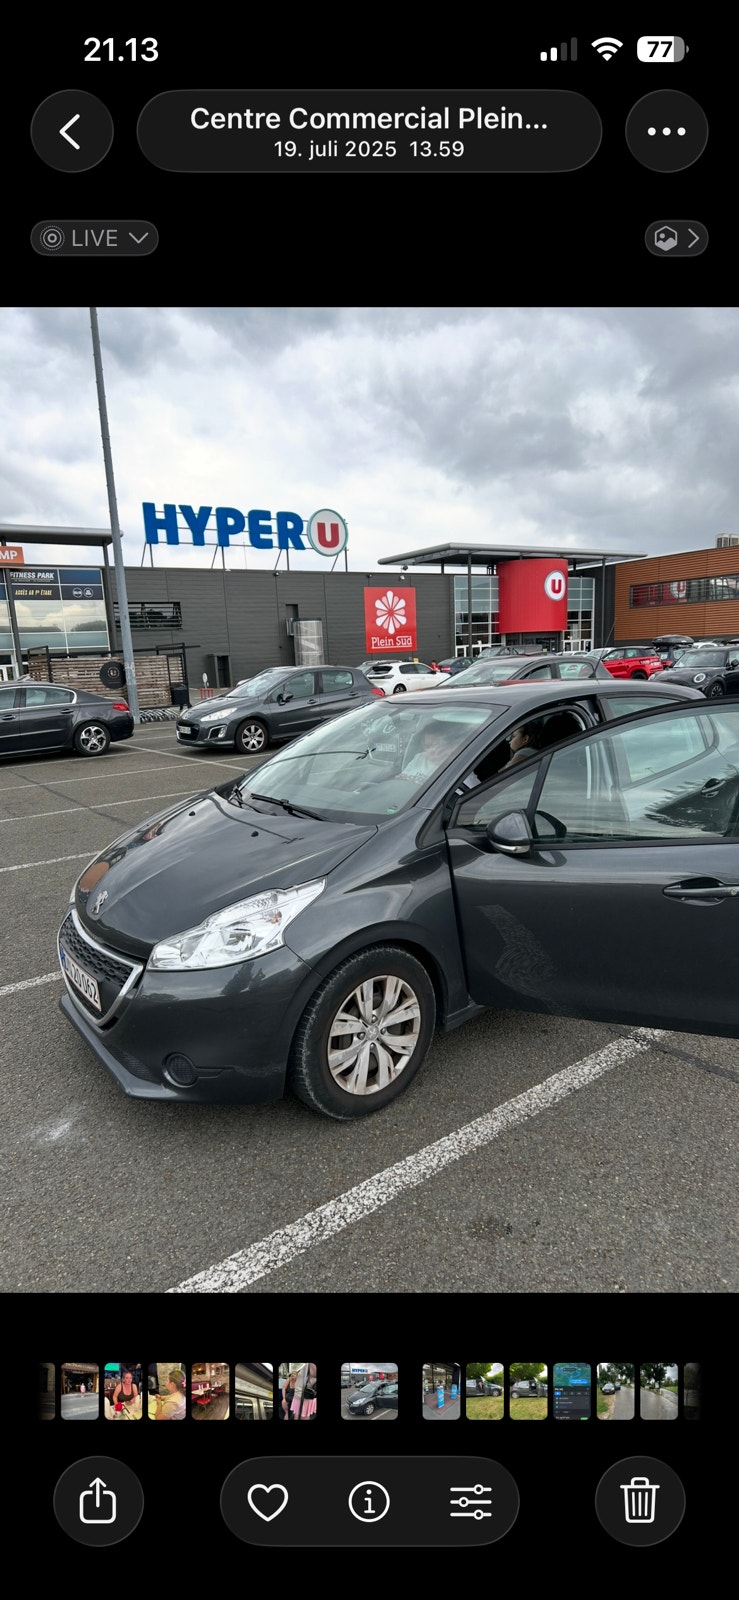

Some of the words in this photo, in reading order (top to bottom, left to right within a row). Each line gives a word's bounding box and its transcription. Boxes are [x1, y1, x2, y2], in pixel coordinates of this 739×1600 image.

[142, 502, 306, 551] HYPER
[317, 522, 340, 549] U
[10, 571, 36, 579] FITNESS
[550, 578, 562, 594] U
[371, 636, 394, 649] Plein
[396, 635, 413, 648] Sud
